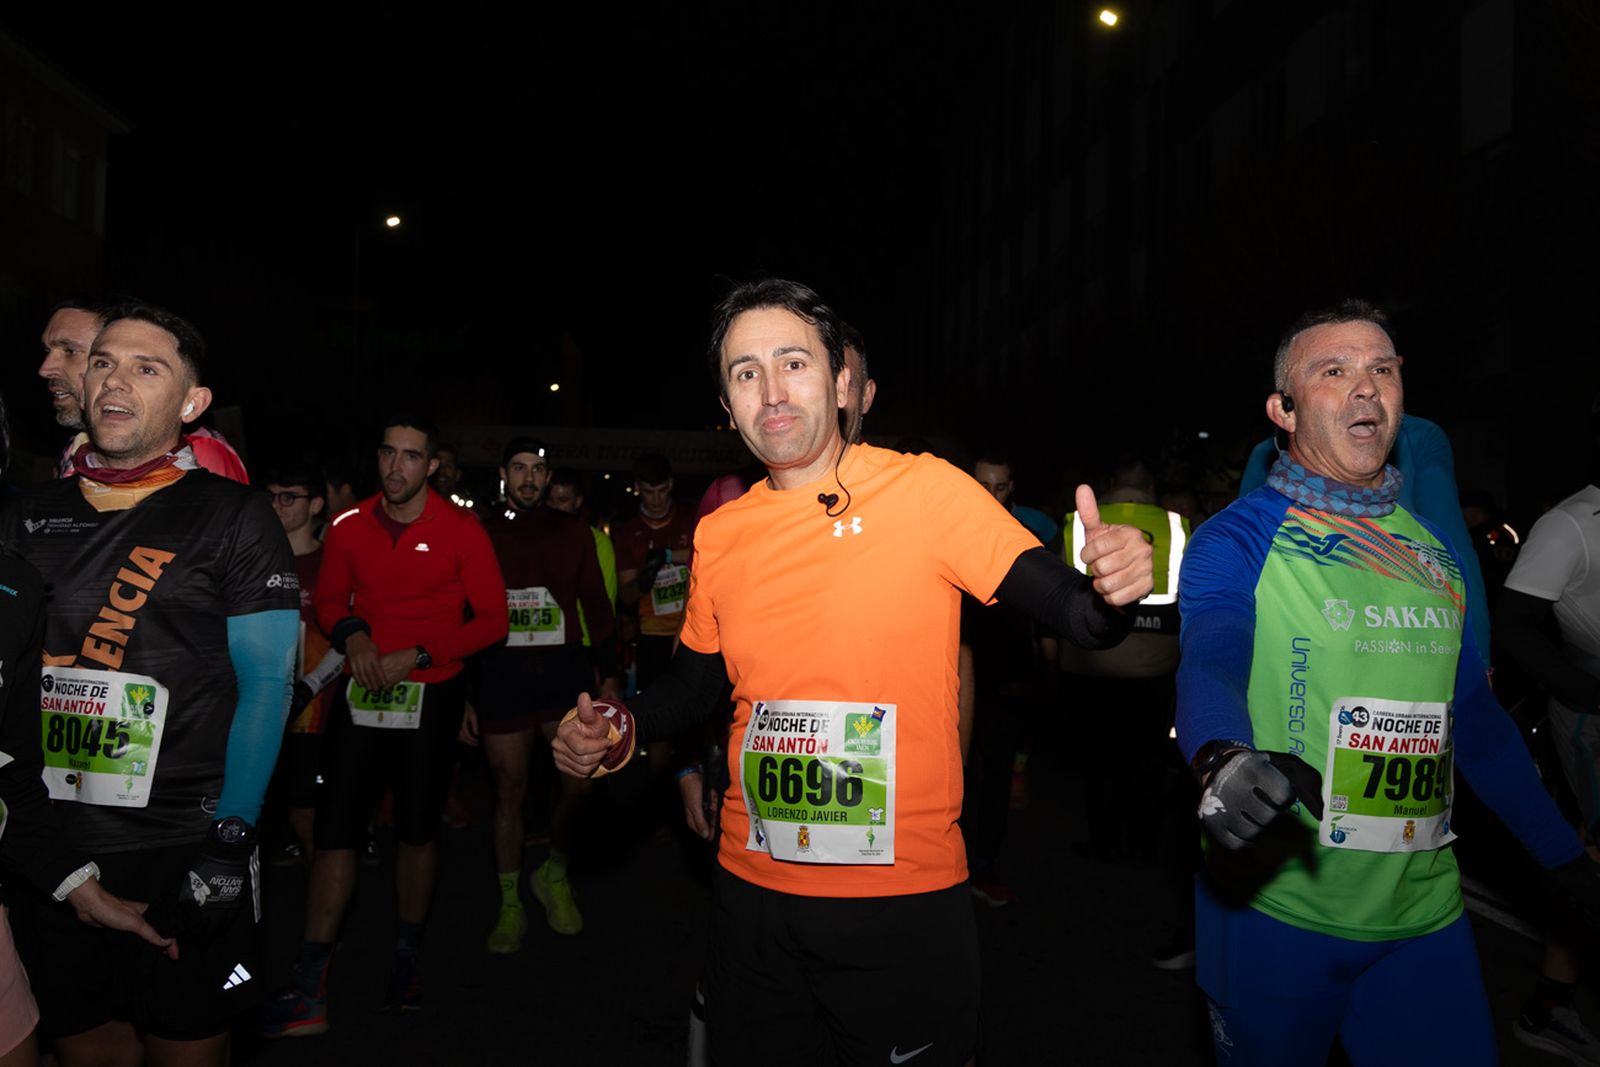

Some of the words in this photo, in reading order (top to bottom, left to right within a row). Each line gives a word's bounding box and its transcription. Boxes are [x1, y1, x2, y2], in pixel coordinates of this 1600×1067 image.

[80, 545, 176, 670] ENCIA
[1364, 605, 1461, 630] SAKATA
[1415, 641, 1427, 653] in
[54, 682, 89, 697] NOCHE
[90, 685, 109, 698] DE
[1288, 637, 1311, 734] Universo
[41, 696, 62, 711] SAN
[63, 697, 106, 716] ANTÓN
[1352, 710, 1368, 722] 43
[767, 717, 806, 733] NOCHE
[810, 719, 830, 733] DE
[1372, 716, 1422, 734] NOCHE
[1423, 720, 1442, 734] DE
[46, 714, 130, 759] 8045
[752, 735, 775, 752] SAN
[777, 733, 829, 754] ANTÓN
[1348, 732, 1386, 751] SAN
[1388, 734, 1440, 754] ANTÓN
[758, 755, 864, 808] 6696
[1362, 754, 1447, 801] 7989
[767, 807, 808, 820] LORENZO
[810, 810, 849, 822] JAVIER
[1393, 804, 1427, 816] Manuel
